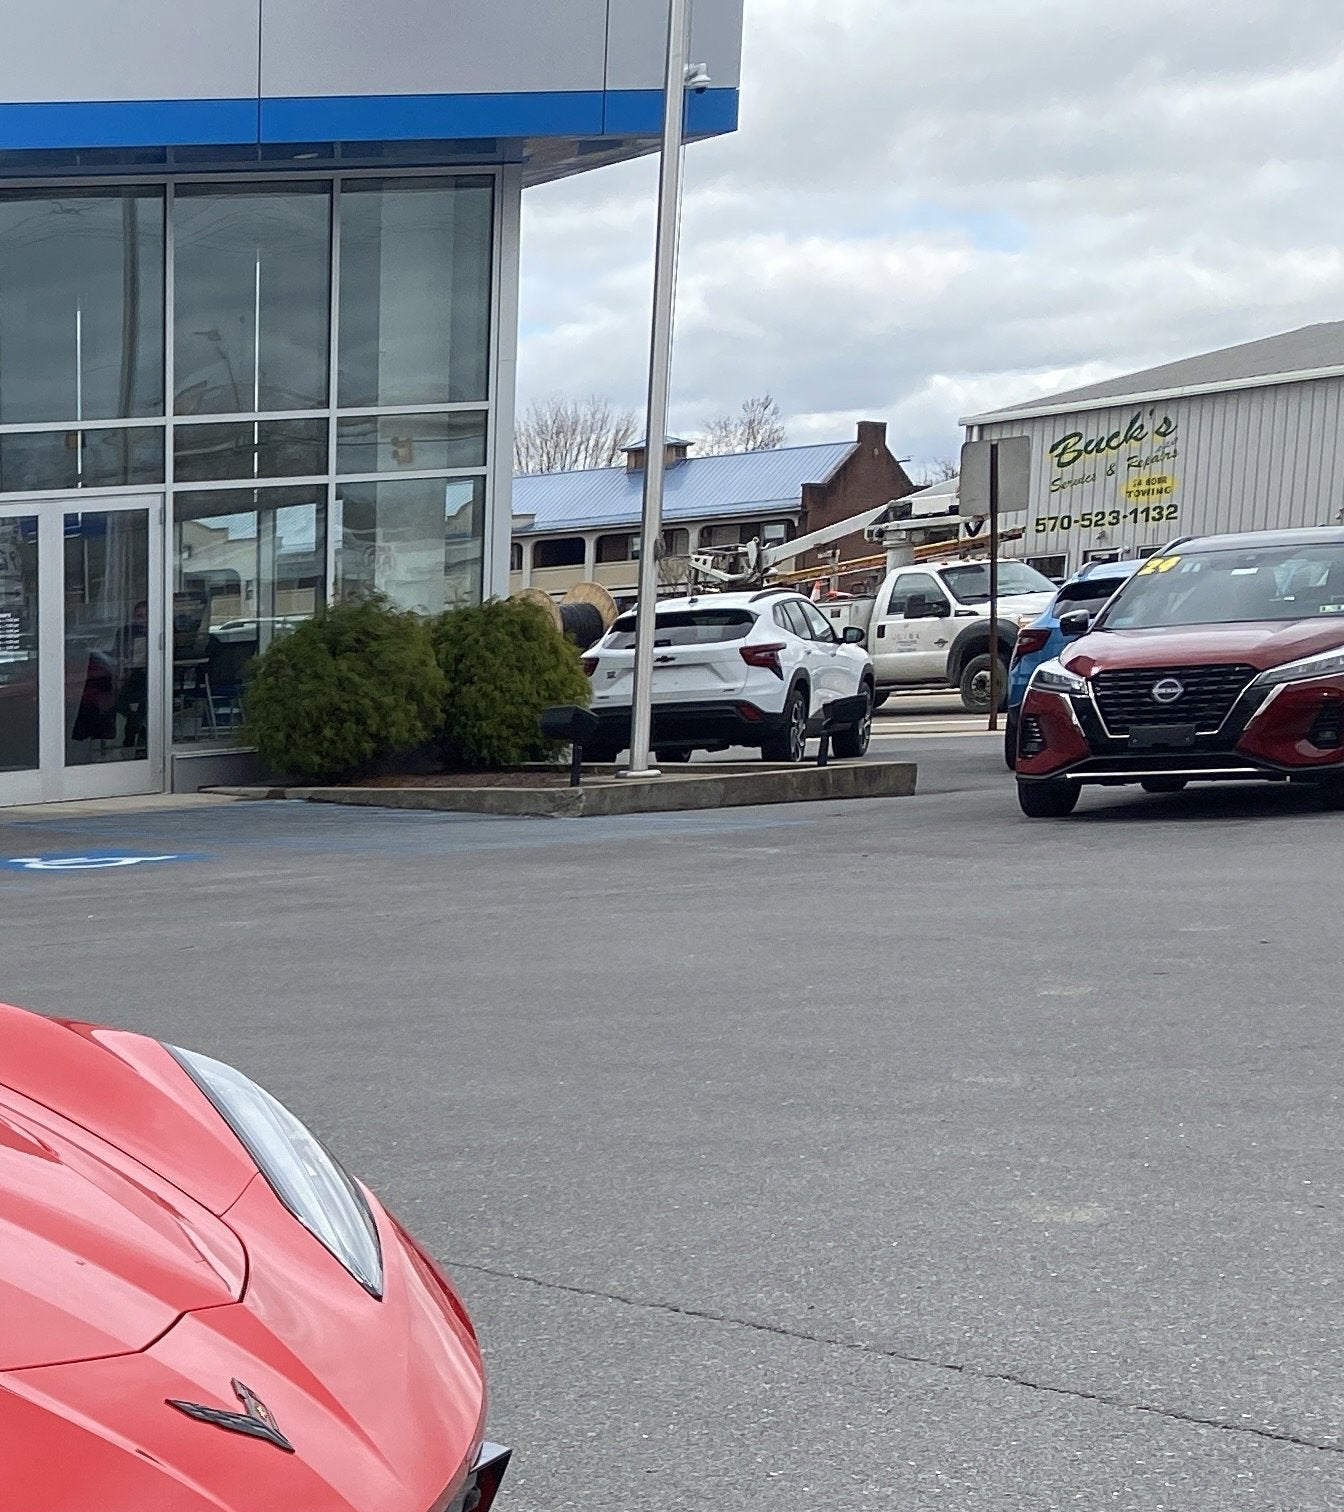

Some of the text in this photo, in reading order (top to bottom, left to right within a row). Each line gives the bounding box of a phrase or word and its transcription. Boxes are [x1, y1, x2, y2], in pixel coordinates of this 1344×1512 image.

[1048, 408, 1179, 468] Buck's
[1107, 463, 1117, 477] &
[1126, 486, 1172, 499] TOWING
[1034, 502, 1179, 534] 570-523-1132
[1137, 555, 1182, 577] 24
